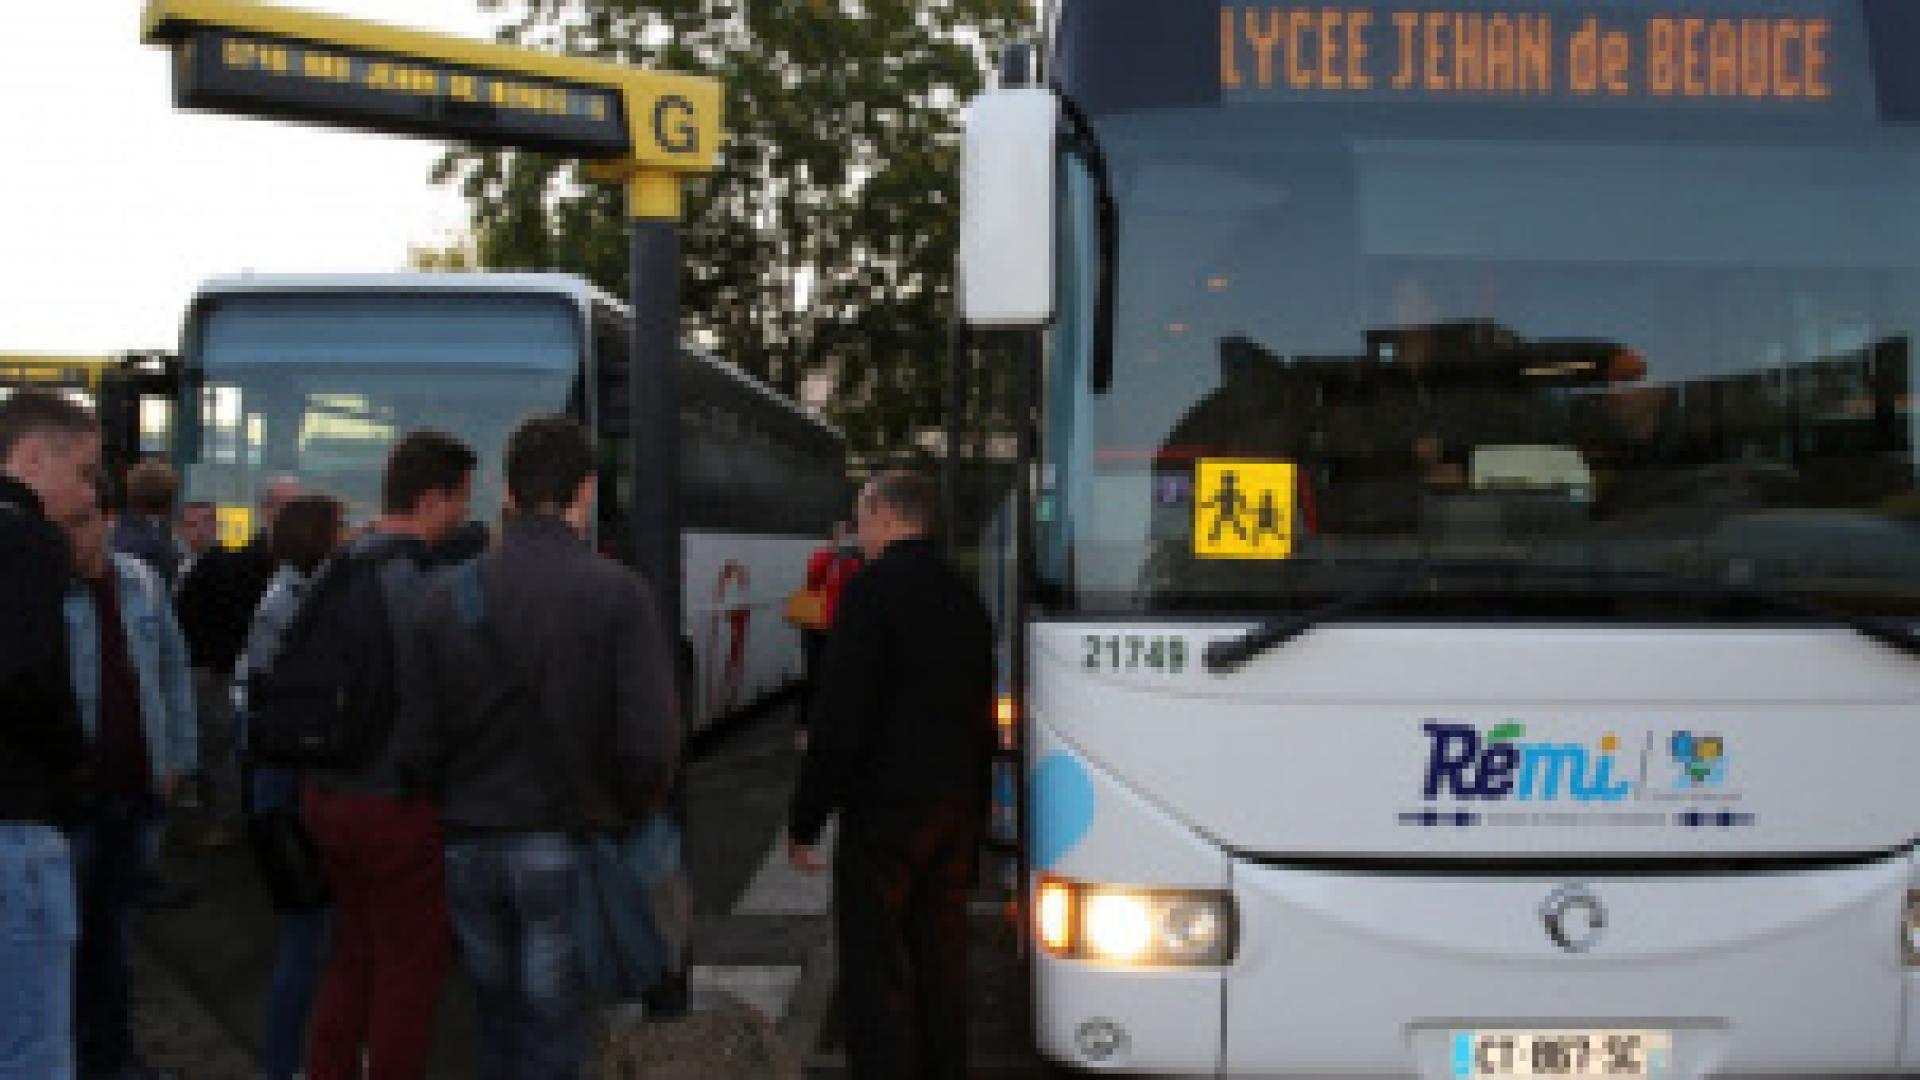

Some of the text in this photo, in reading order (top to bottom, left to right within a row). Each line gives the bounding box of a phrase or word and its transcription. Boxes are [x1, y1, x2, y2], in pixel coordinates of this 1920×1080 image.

[1219, 7, 1832, 97] LYCEE JEHAN de BEAUCE
[653, 94, 697, 153] G
[1421, 719, 1629, 801] Rémi
